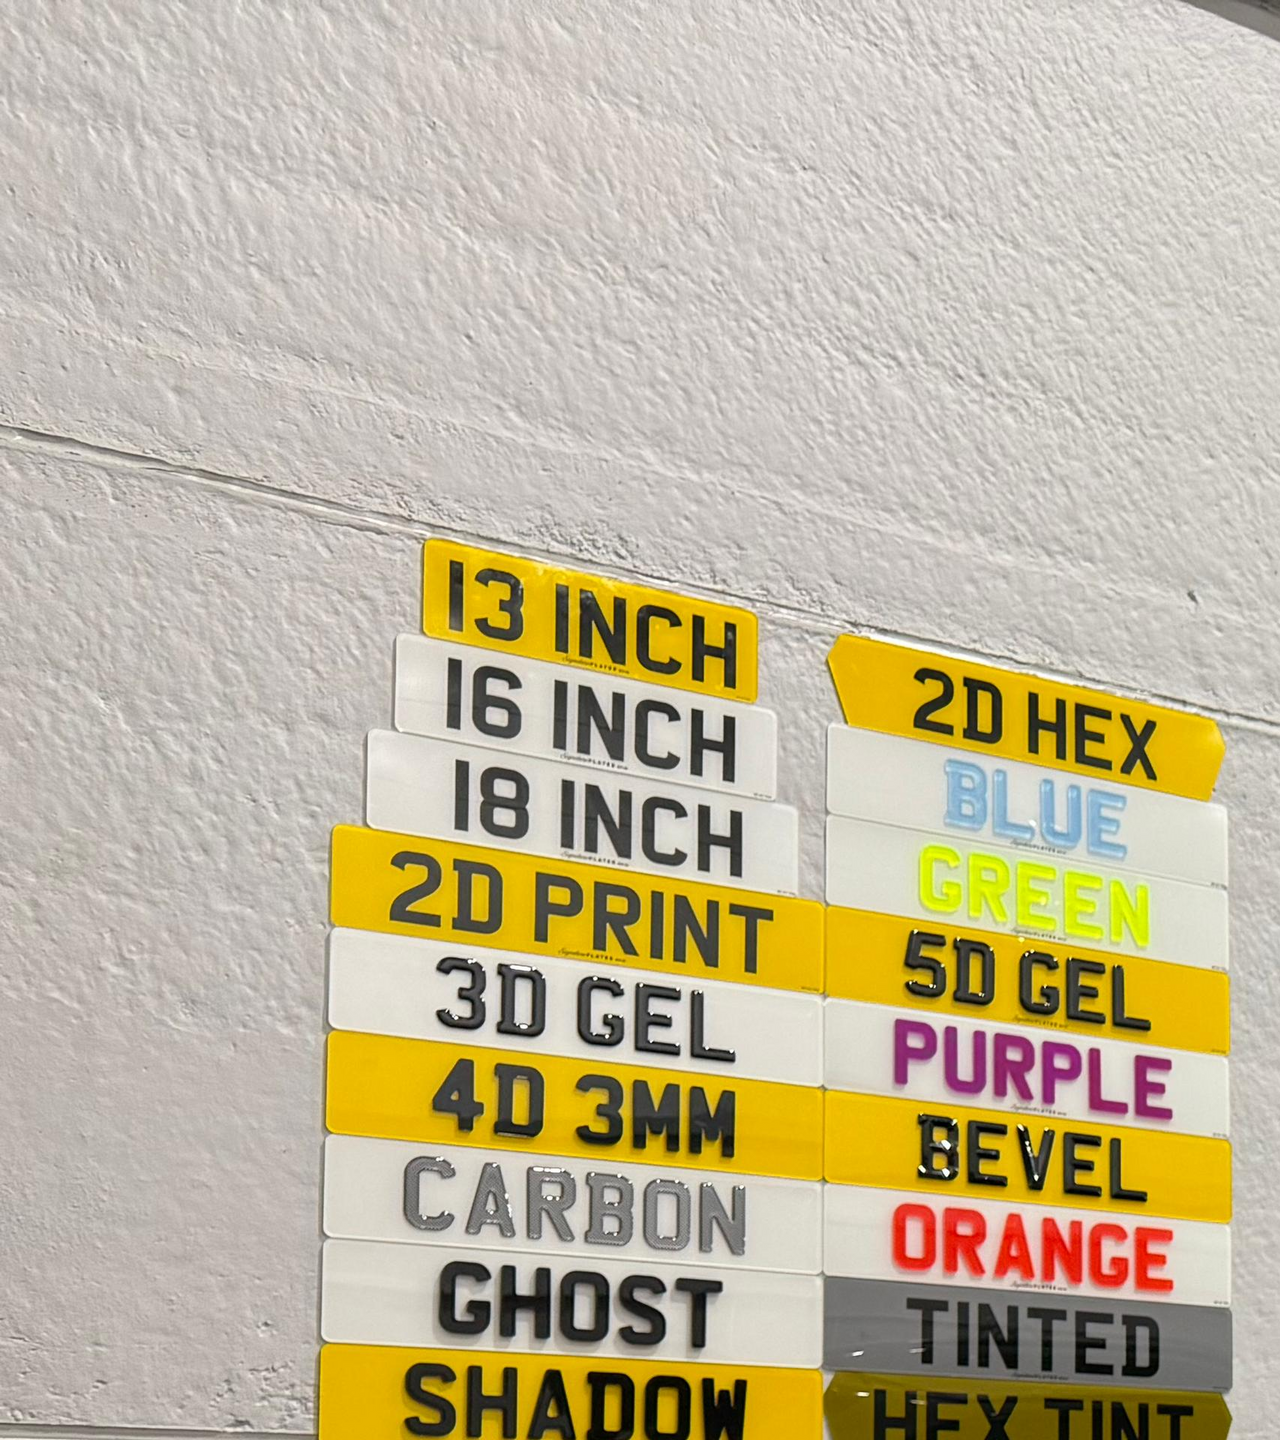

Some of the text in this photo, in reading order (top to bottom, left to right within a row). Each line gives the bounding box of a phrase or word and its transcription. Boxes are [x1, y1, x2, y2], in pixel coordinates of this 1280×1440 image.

[448, 560, 737, 689] 13 INCH
[446, 657, 736, 784] 16 INCH
[913, 667, 1157, 781] 2D HEX
[454, 759, 743, 877] 18 INCH
[943, 758, 1127, 860] BLUE
[389, 850, 775, 975] 2D PRINT
[918, 843, 1149, 947] GREEN
[436, 956, 736, 1063] 3D GEL
[904, 929, 1151, 1032] 5D GEL
[432, 1058, 736, 1158] 4D 3MM
[893, 1018, 1173, 1121] PURPLE
[403, 1155, 747, 1256] CARBON
[918, 1112, 1148, 1202] BEVEL
[892, 1203, 1174, 1292] ORANGE
[438, 1260, 723, 1349] GHOST
[906, 1297, 1160, 1378] TINTED
